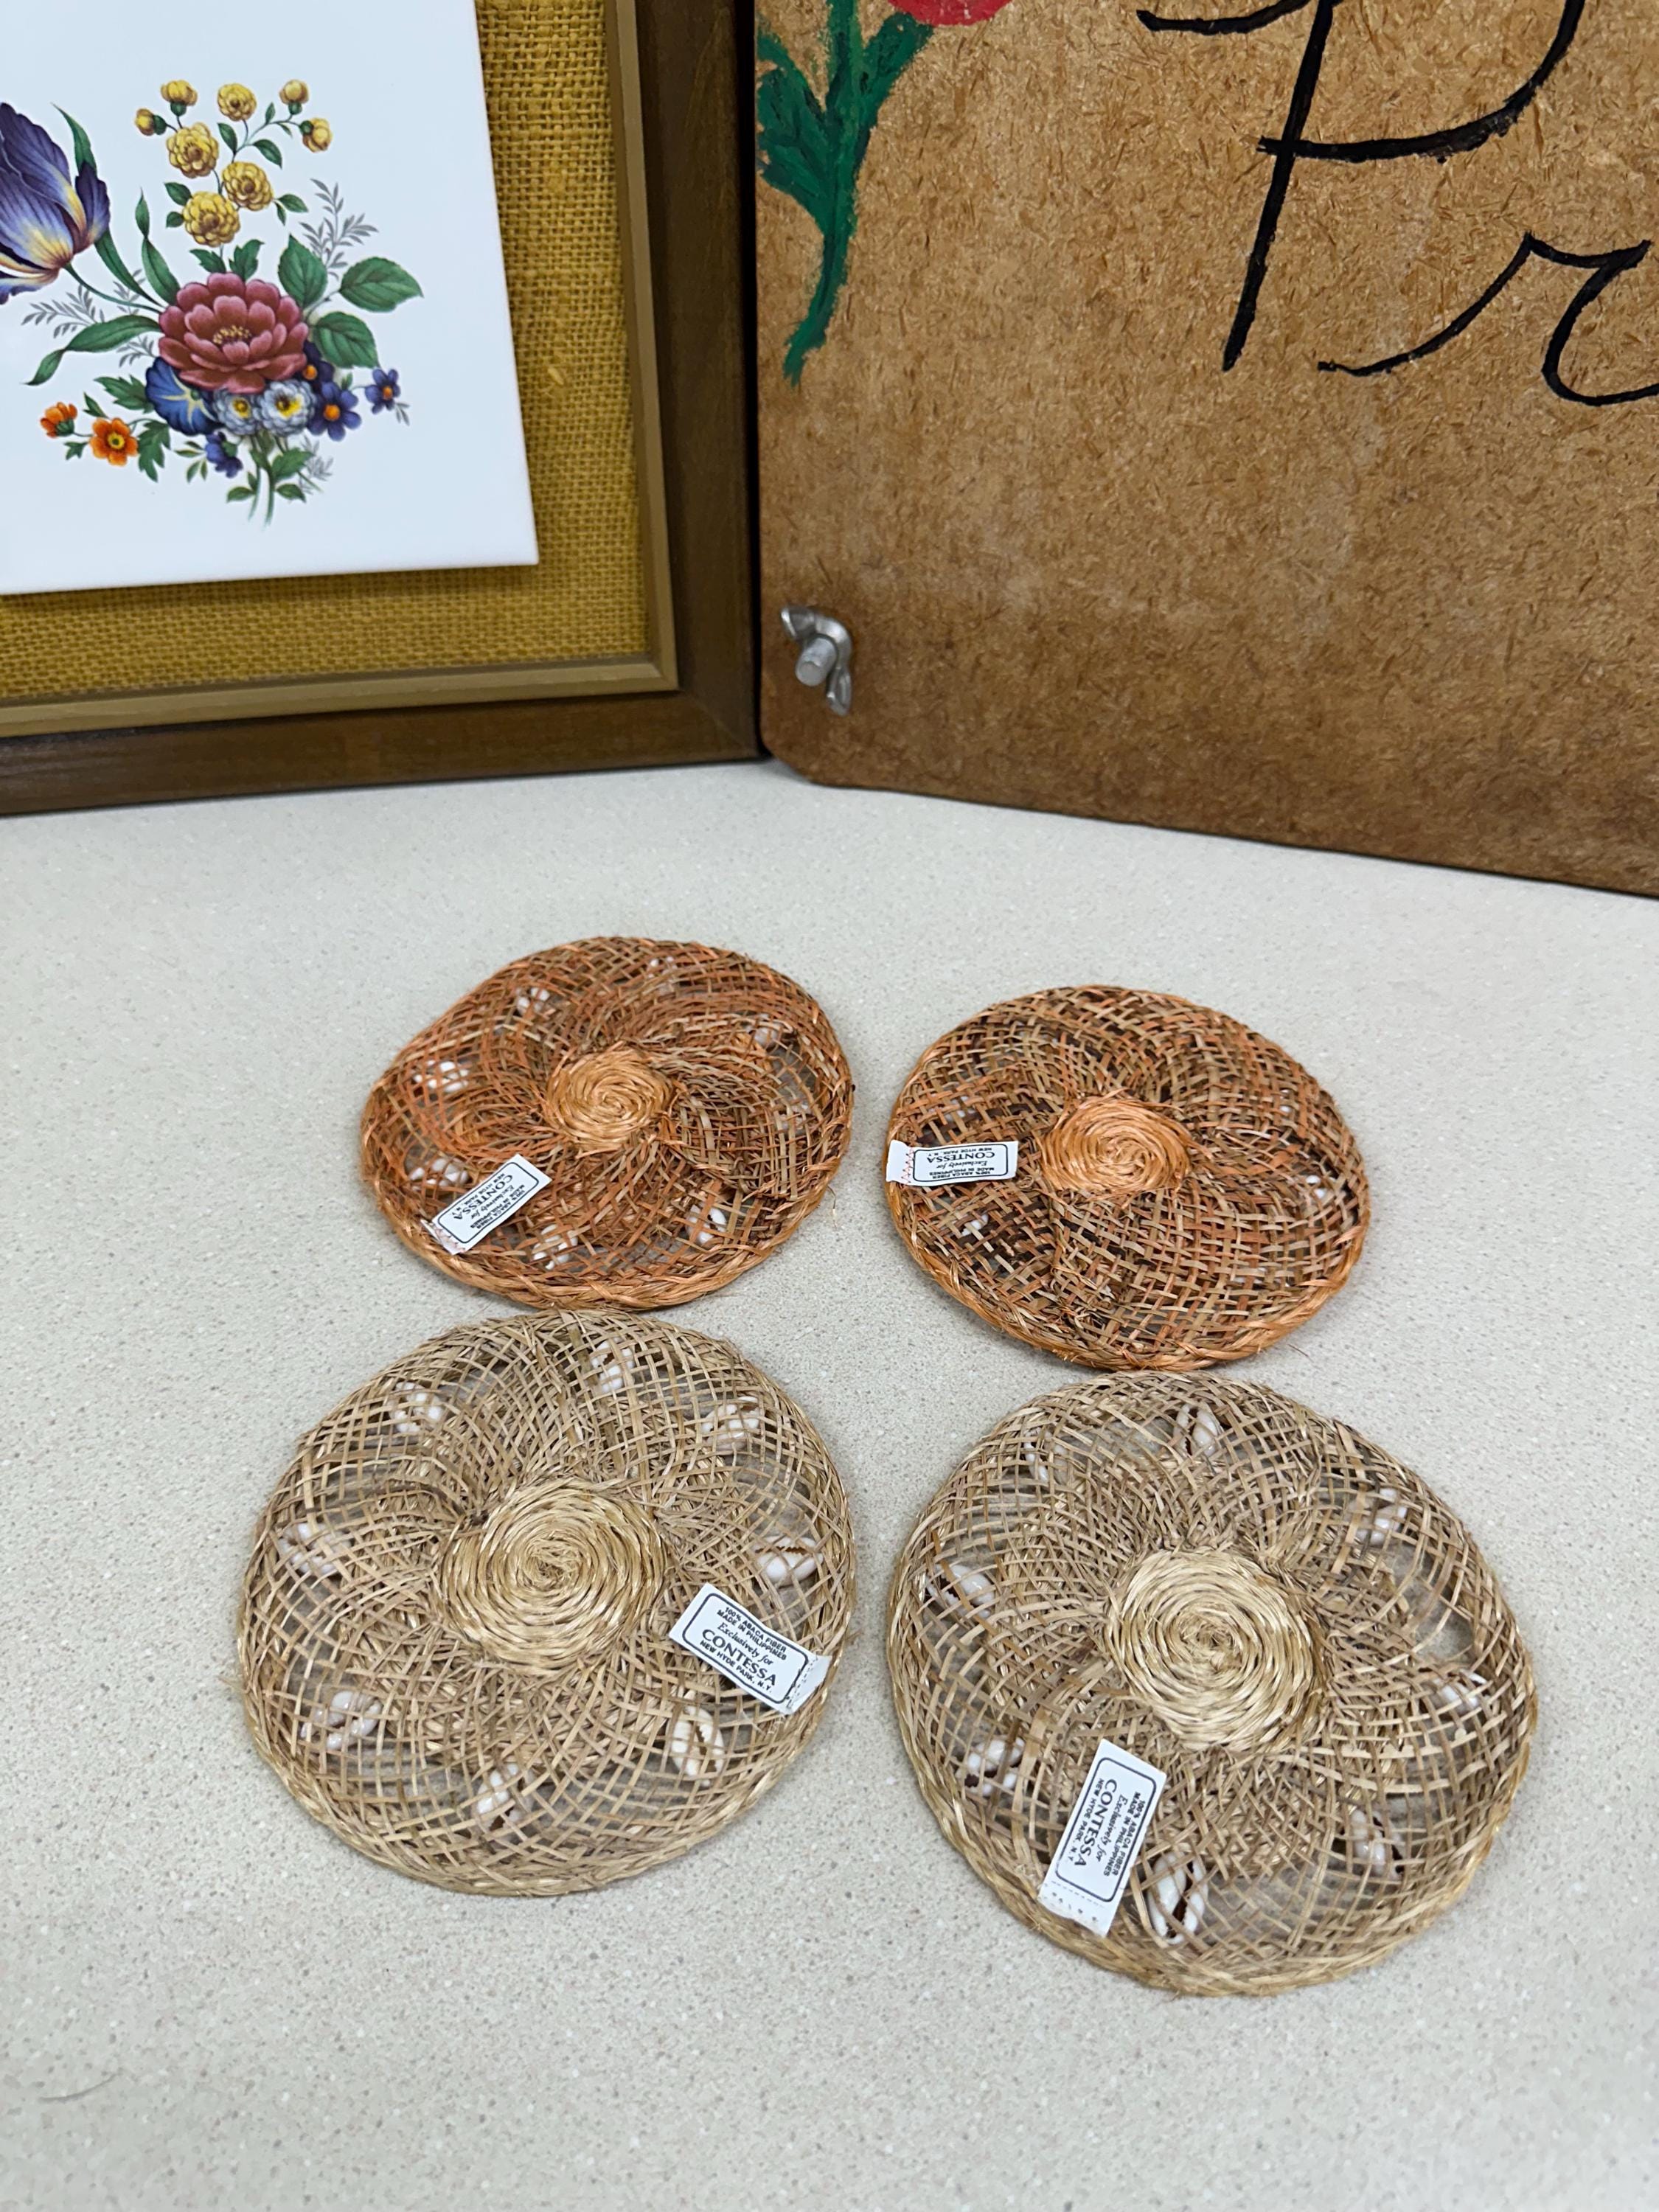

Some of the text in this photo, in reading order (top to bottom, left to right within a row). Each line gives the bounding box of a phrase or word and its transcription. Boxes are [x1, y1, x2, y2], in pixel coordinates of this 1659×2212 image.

[926, 1151, 995, 1163] CONTESSA
[453, 1175, 512, 1220] CONTESSA
[470, 1209, 480, 1219] for
[717, 1609, 787, 1660] MADE IN PHILIPPINES
[717, 1621, 773, 1665] Exclusively for
[725, 1607, 786, 1652] 100% ABACA FIBER
[699, 1639, 773, 1693] NEW HYDE PARK, N.Y.
[702, 1629, 776, 1686] CONTESSA
[1083, 1798, 1096, 1819] HYDE
[1093, 1778, 1105, 1796] NEW
[1073, 1820, 1088, 1843] PARK,
[1074, 1778, 1117, 1865] CONTESSA
[1096, 1794, 1128, 1862] Exclusively for
[1103, 1791, 1141, 1876] MADE IN PHILIPPINES
[1111, 1800, 1145, 1876] 100% ABACA FIBER
